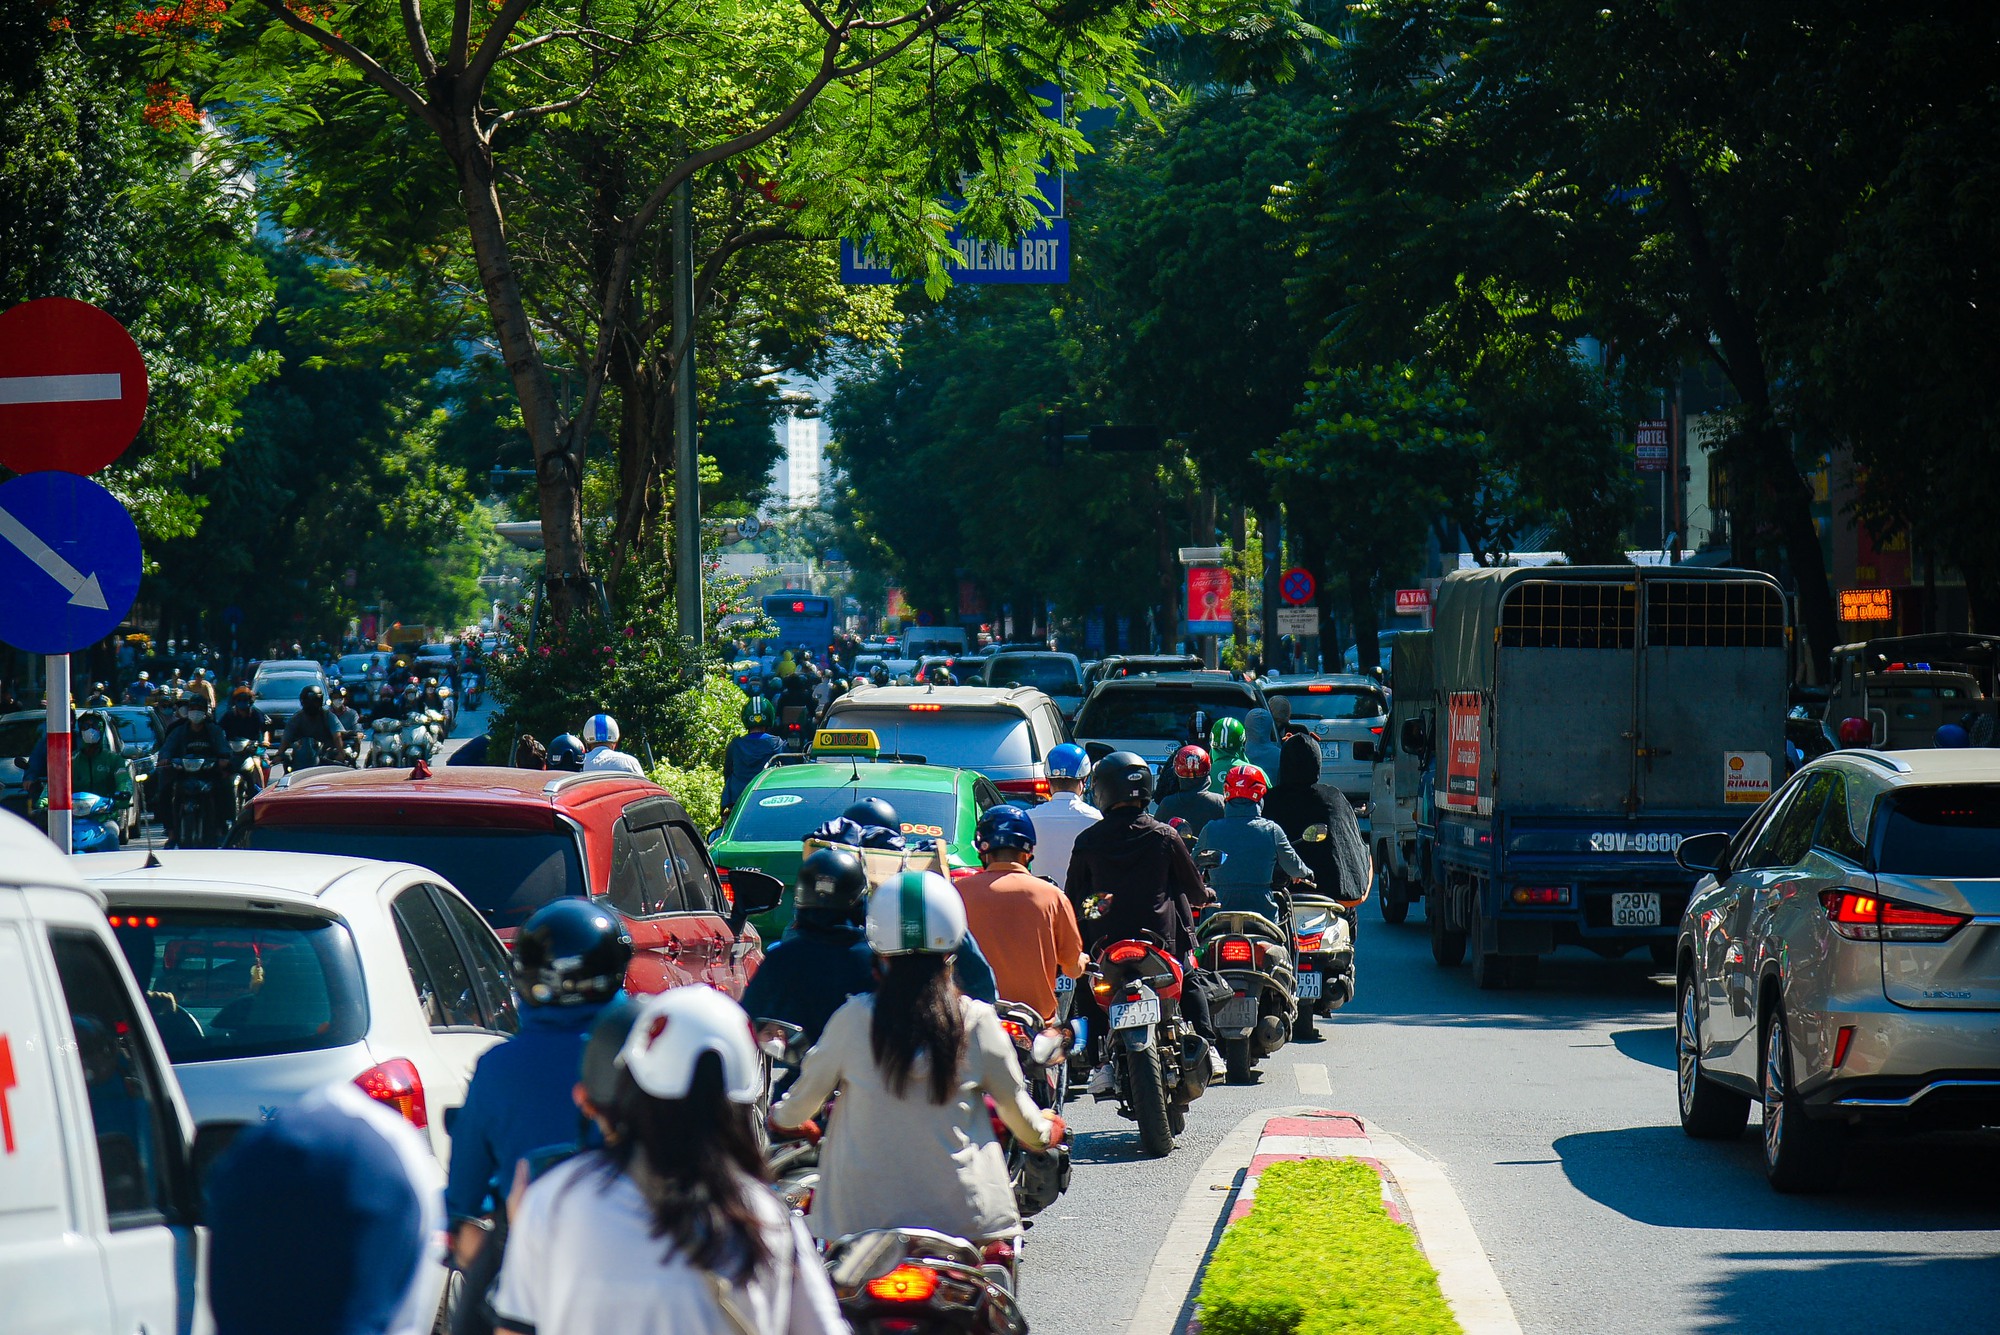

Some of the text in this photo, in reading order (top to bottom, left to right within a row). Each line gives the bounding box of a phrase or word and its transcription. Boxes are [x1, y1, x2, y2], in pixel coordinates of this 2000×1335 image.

[1021, 239, 1059, 271] BRT
[1636, 430, 1668, 445] HOTEL
[1399, 592, 1427, 603] ATM
[832, 732, 868, 746] 1055
[1727, 780, 1769, 788] RIMULA
[1590, 832, 1683, 852] 29V-9800
[1621, 894, 1651, 909] 29V
[1617, 909, 1656, 924] 9800
[1922, 990, 1972, 999] LEXUS
[1117, 1001, 1150, 1016] 29-Y1
[1114, 1012, 1156, 1027] 673.22
